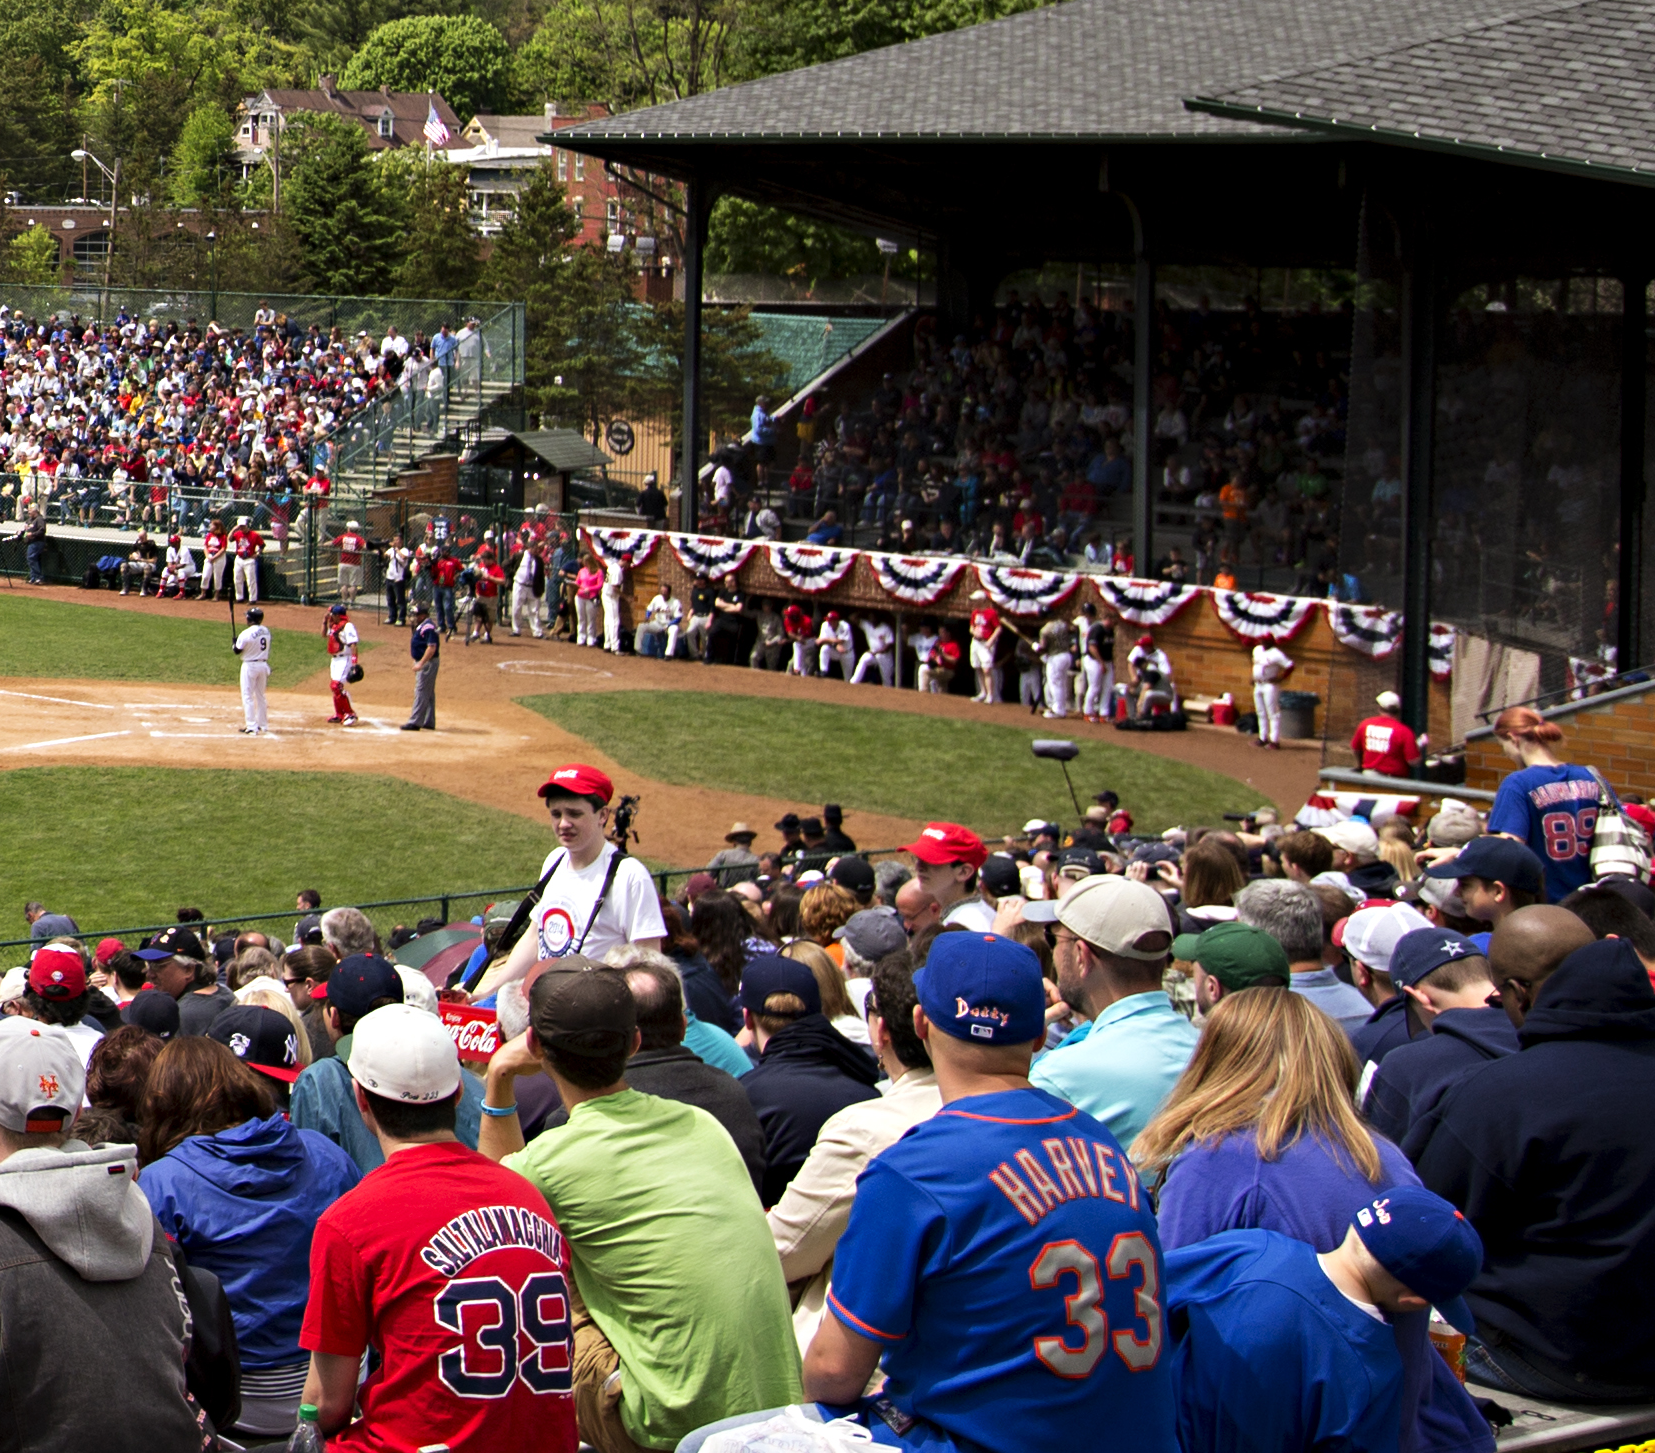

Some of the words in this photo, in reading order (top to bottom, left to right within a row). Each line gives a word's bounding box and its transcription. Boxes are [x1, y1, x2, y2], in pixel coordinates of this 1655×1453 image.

[260, 637, 267, 651] 9
[989, 1137, 1139, 1226] HARVEY
[420, 1205, 562, 1278] SALTALAMACCHIA
[433, 1271, 574, 1399] 39
[1029, 1231, 1163, 1379] 33
